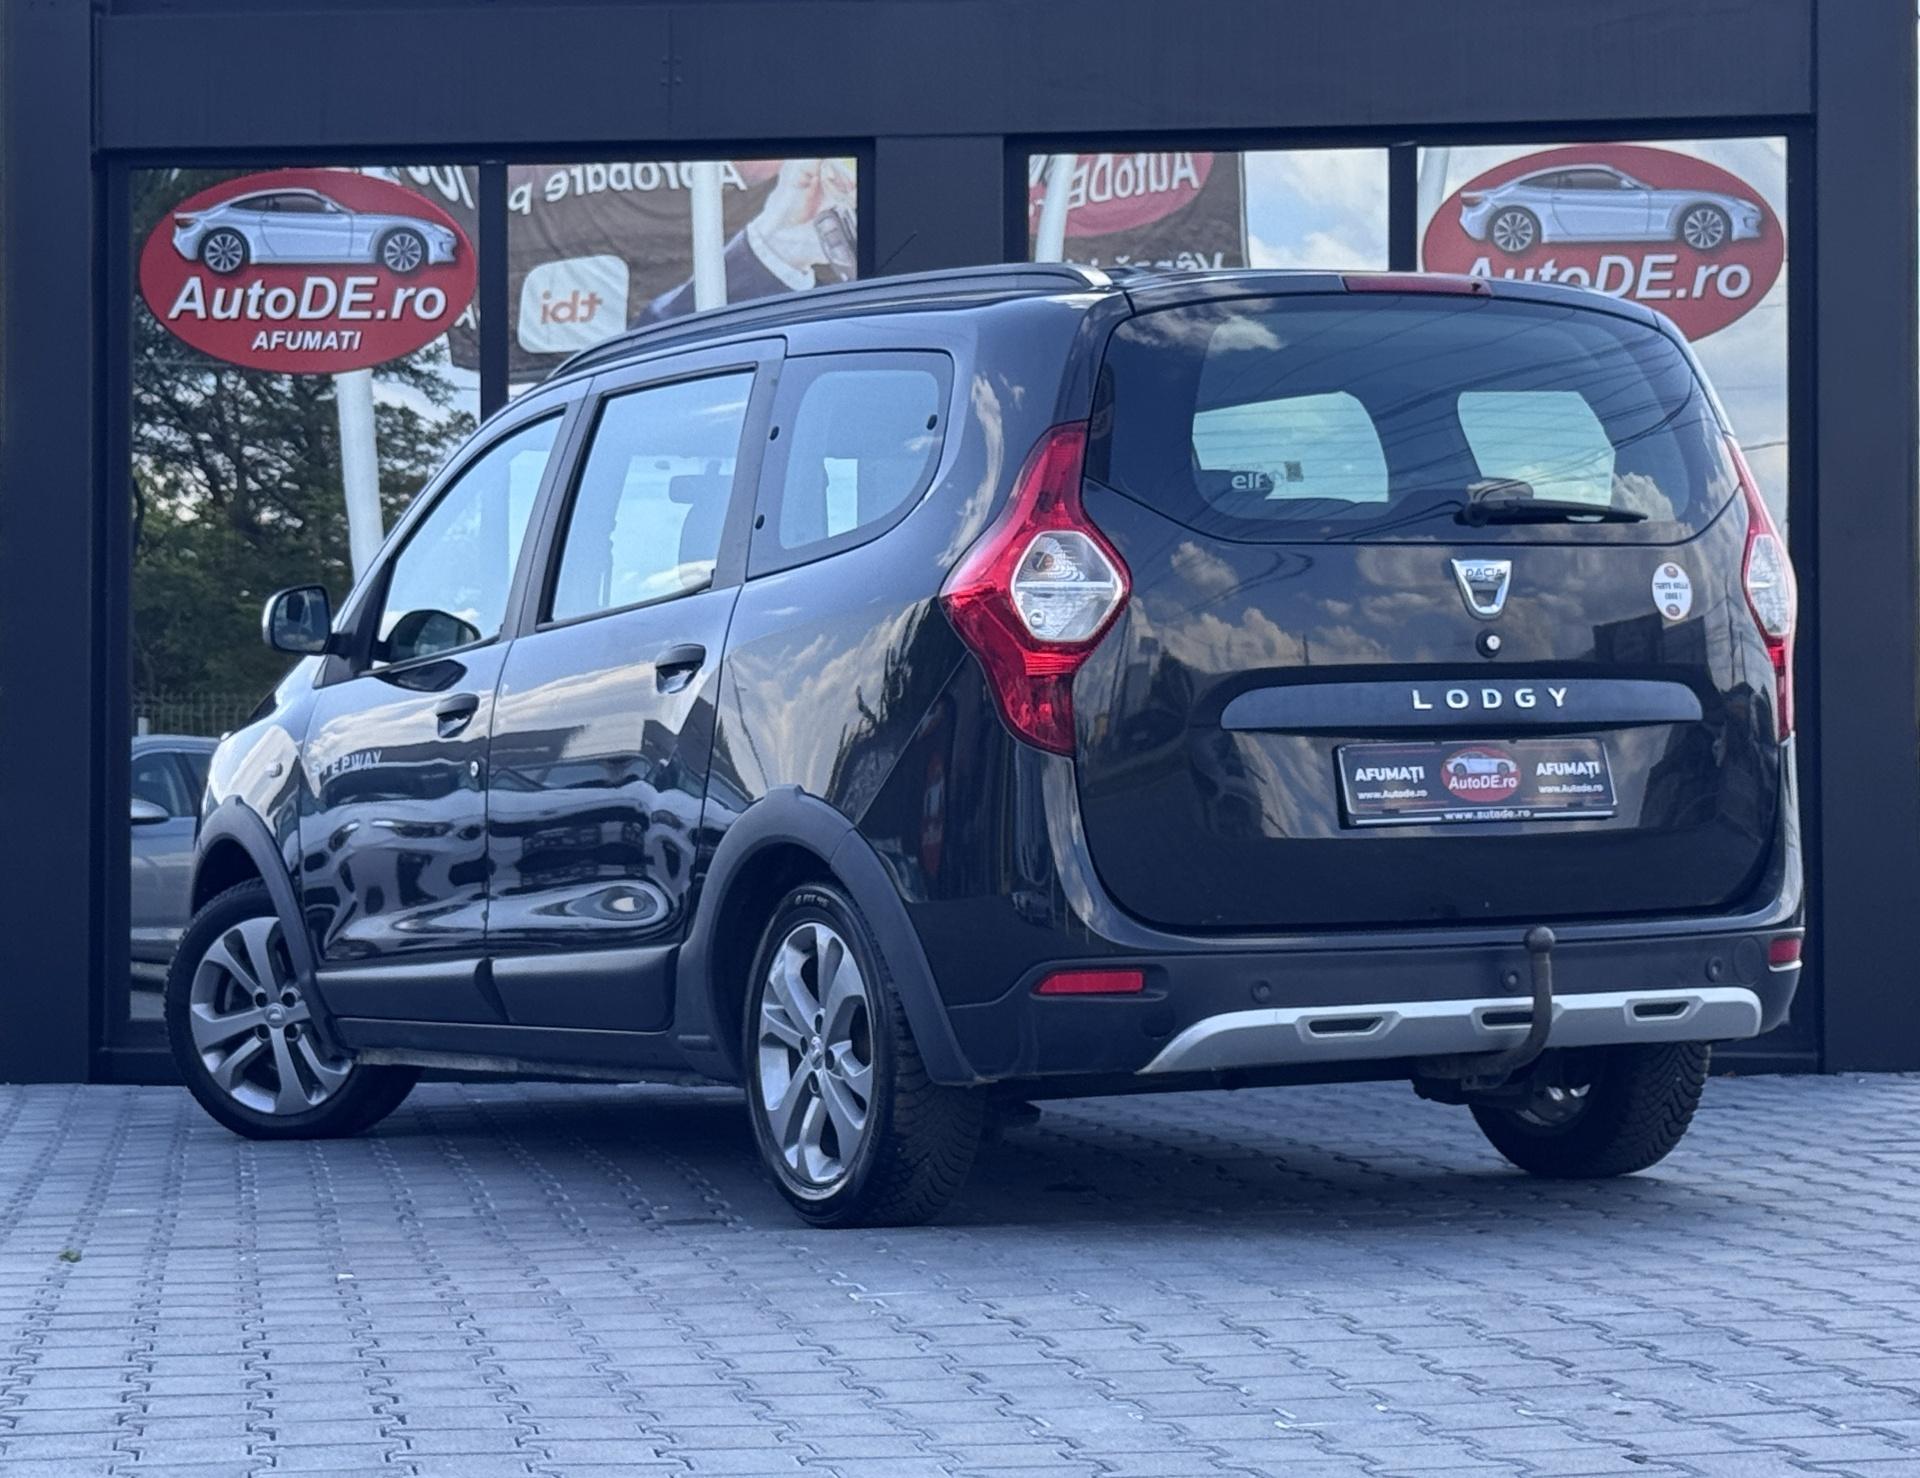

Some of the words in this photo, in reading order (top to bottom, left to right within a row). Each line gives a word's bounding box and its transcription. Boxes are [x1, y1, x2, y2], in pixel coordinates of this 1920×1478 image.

[167, 276, 448, 321] AutoDE.ro
[251, 331, 363, 351] AFUMATI
[1231, 472, 1266, 489] elf
[1411, 687, 1568, 710] LODGY
[1448, 775, 1518, 790] AutoDE.ro
